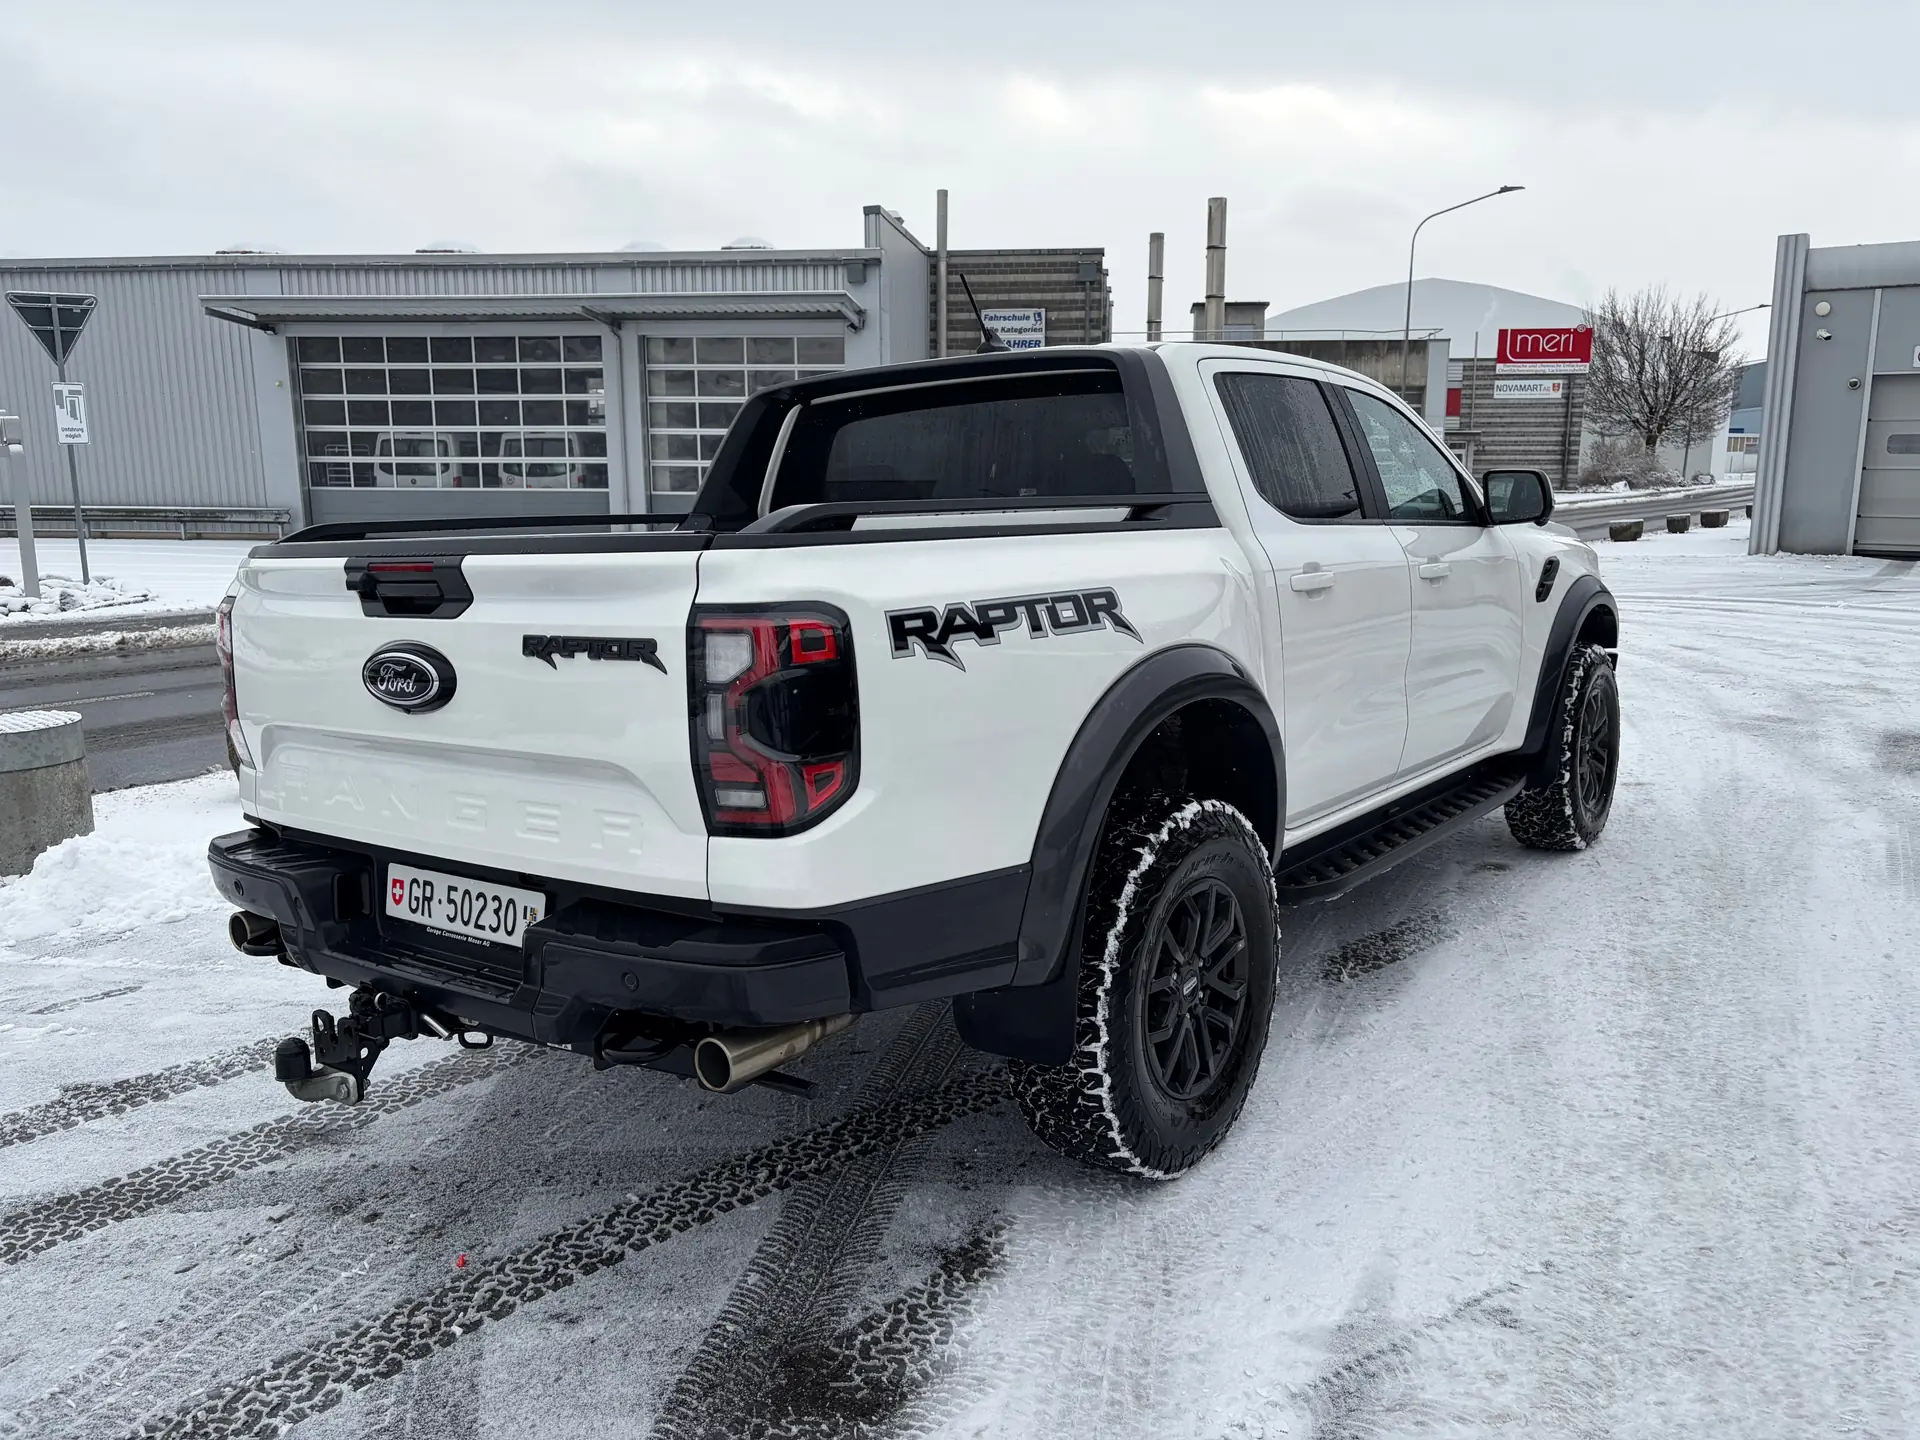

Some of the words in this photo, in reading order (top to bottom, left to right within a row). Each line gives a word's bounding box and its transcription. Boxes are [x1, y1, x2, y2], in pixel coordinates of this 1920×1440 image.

[983, 313, 1031, 321] Fahrschule
[1000, 326, 1043, 334] Kategorien
[1003, 339, 1042, 348] AHRER
[1495, 383, 1544, 393] NOVAMART
[884, 586, 1144, 673] RAPTOR
[522, 634, 668, 676] RAPTOR
[377, 662, 417, 694] Ford
[259, 761, 643, 855] RANGER
[426, 926, 441, 936] Garage
